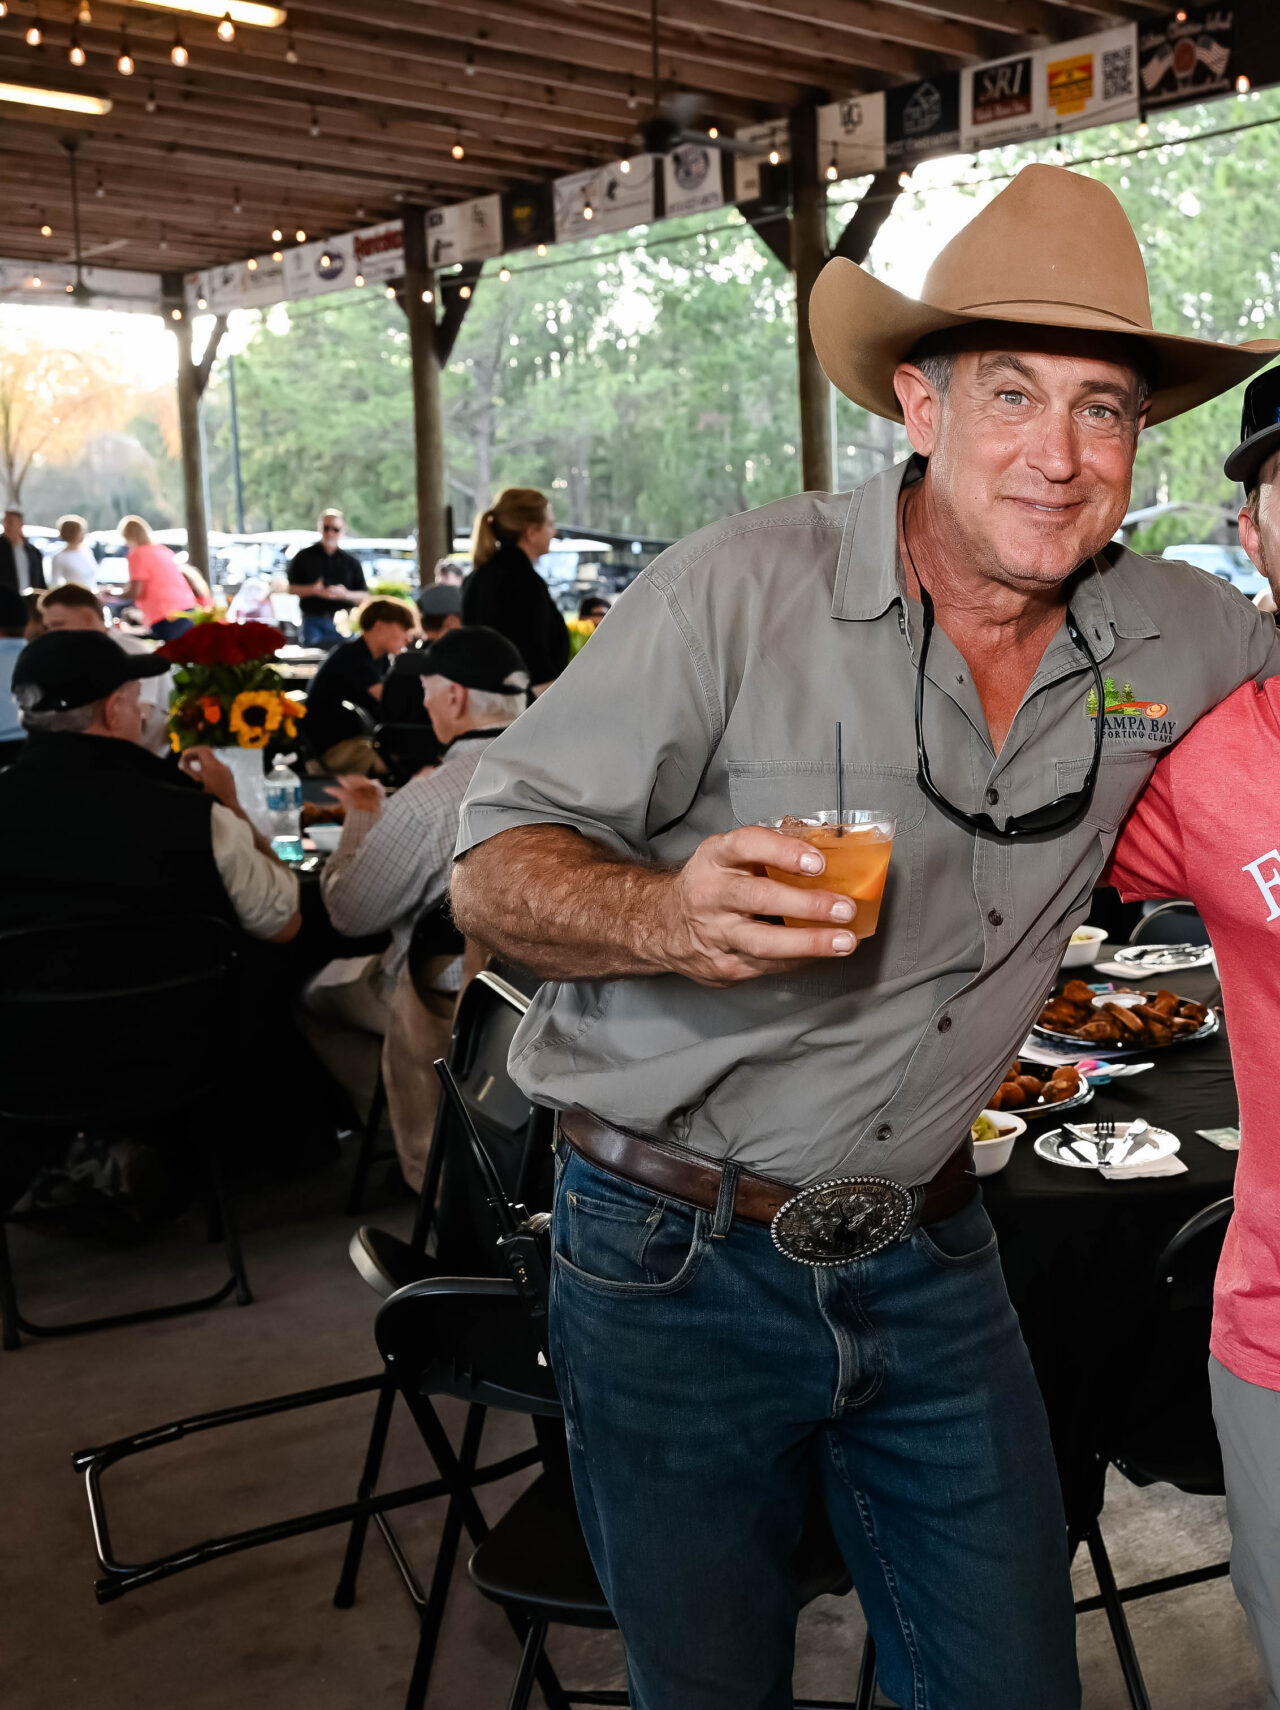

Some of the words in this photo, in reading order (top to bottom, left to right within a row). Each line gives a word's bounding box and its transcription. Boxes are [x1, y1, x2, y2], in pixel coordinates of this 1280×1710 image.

[1151, 719, 1177, 735] BAY
[1095, 730, 1145, 739] PORTING
[1148, 732, 1173, 743] CLAYS
